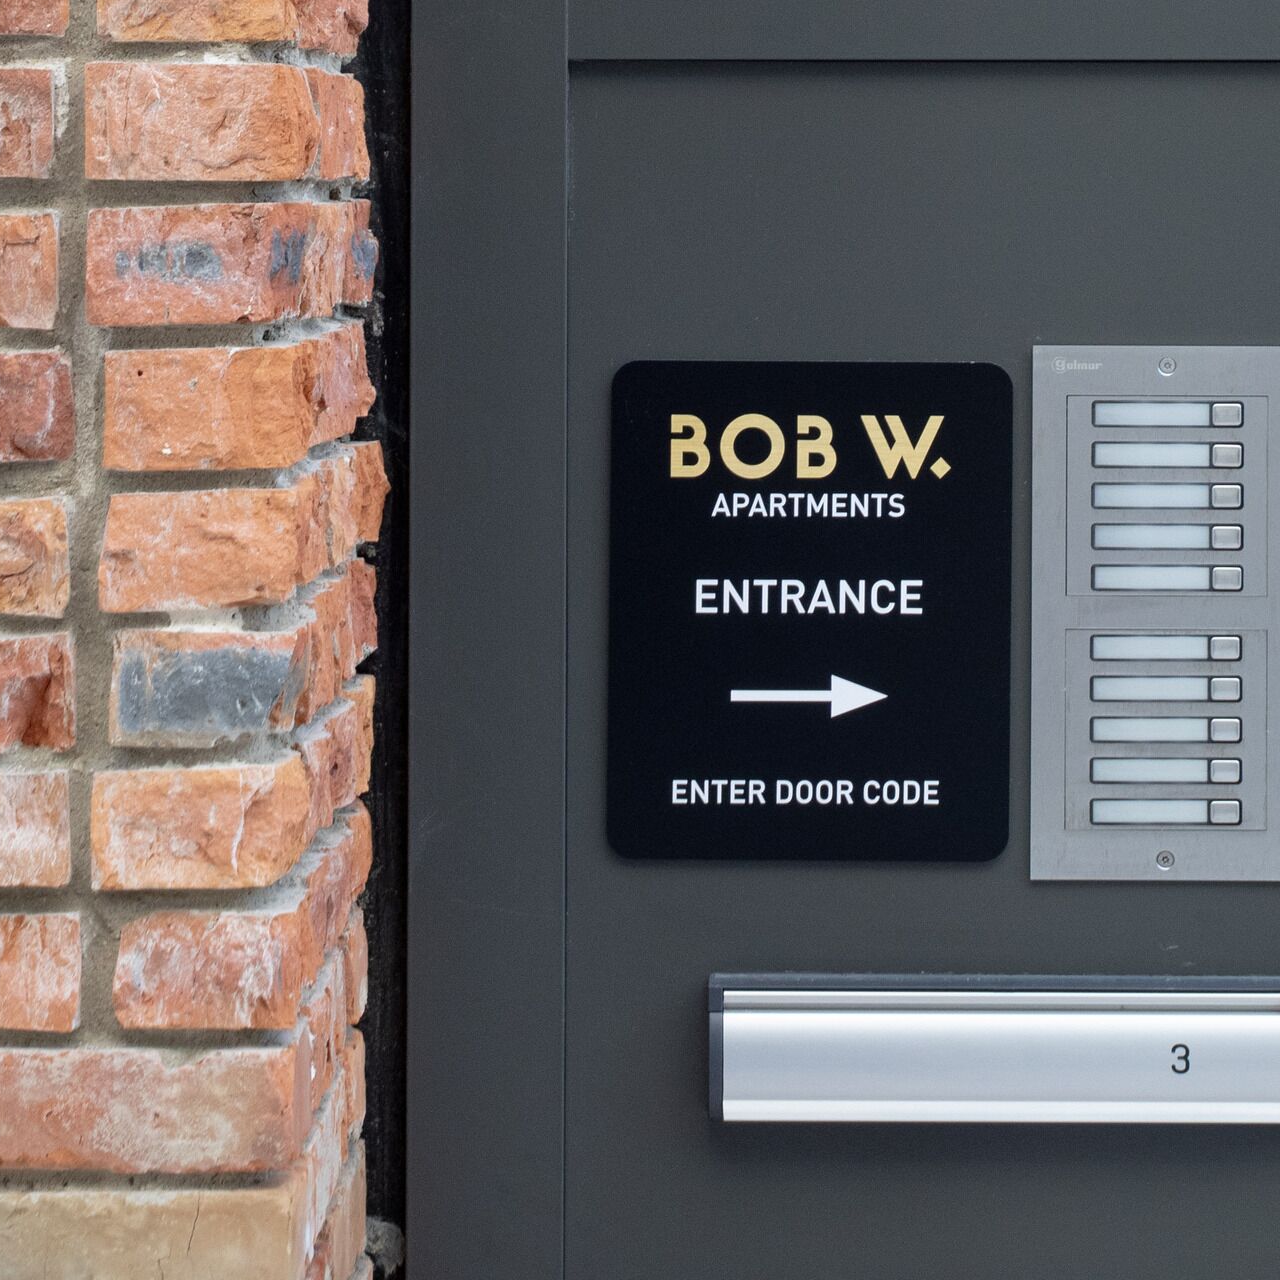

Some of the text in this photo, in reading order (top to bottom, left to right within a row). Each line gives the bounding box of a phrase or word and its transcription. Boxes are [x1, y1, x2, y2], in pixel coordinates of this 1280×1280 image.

[669, 413, 952, 480] BOB W.
[711, 492, 906, 519] APARTMENTS
[694, 577, 924, 616] ENTRANCE
[670, 778, 941, 806] ENTER DOOR CODE
[1170, 1042, 1192, 1076] 3
